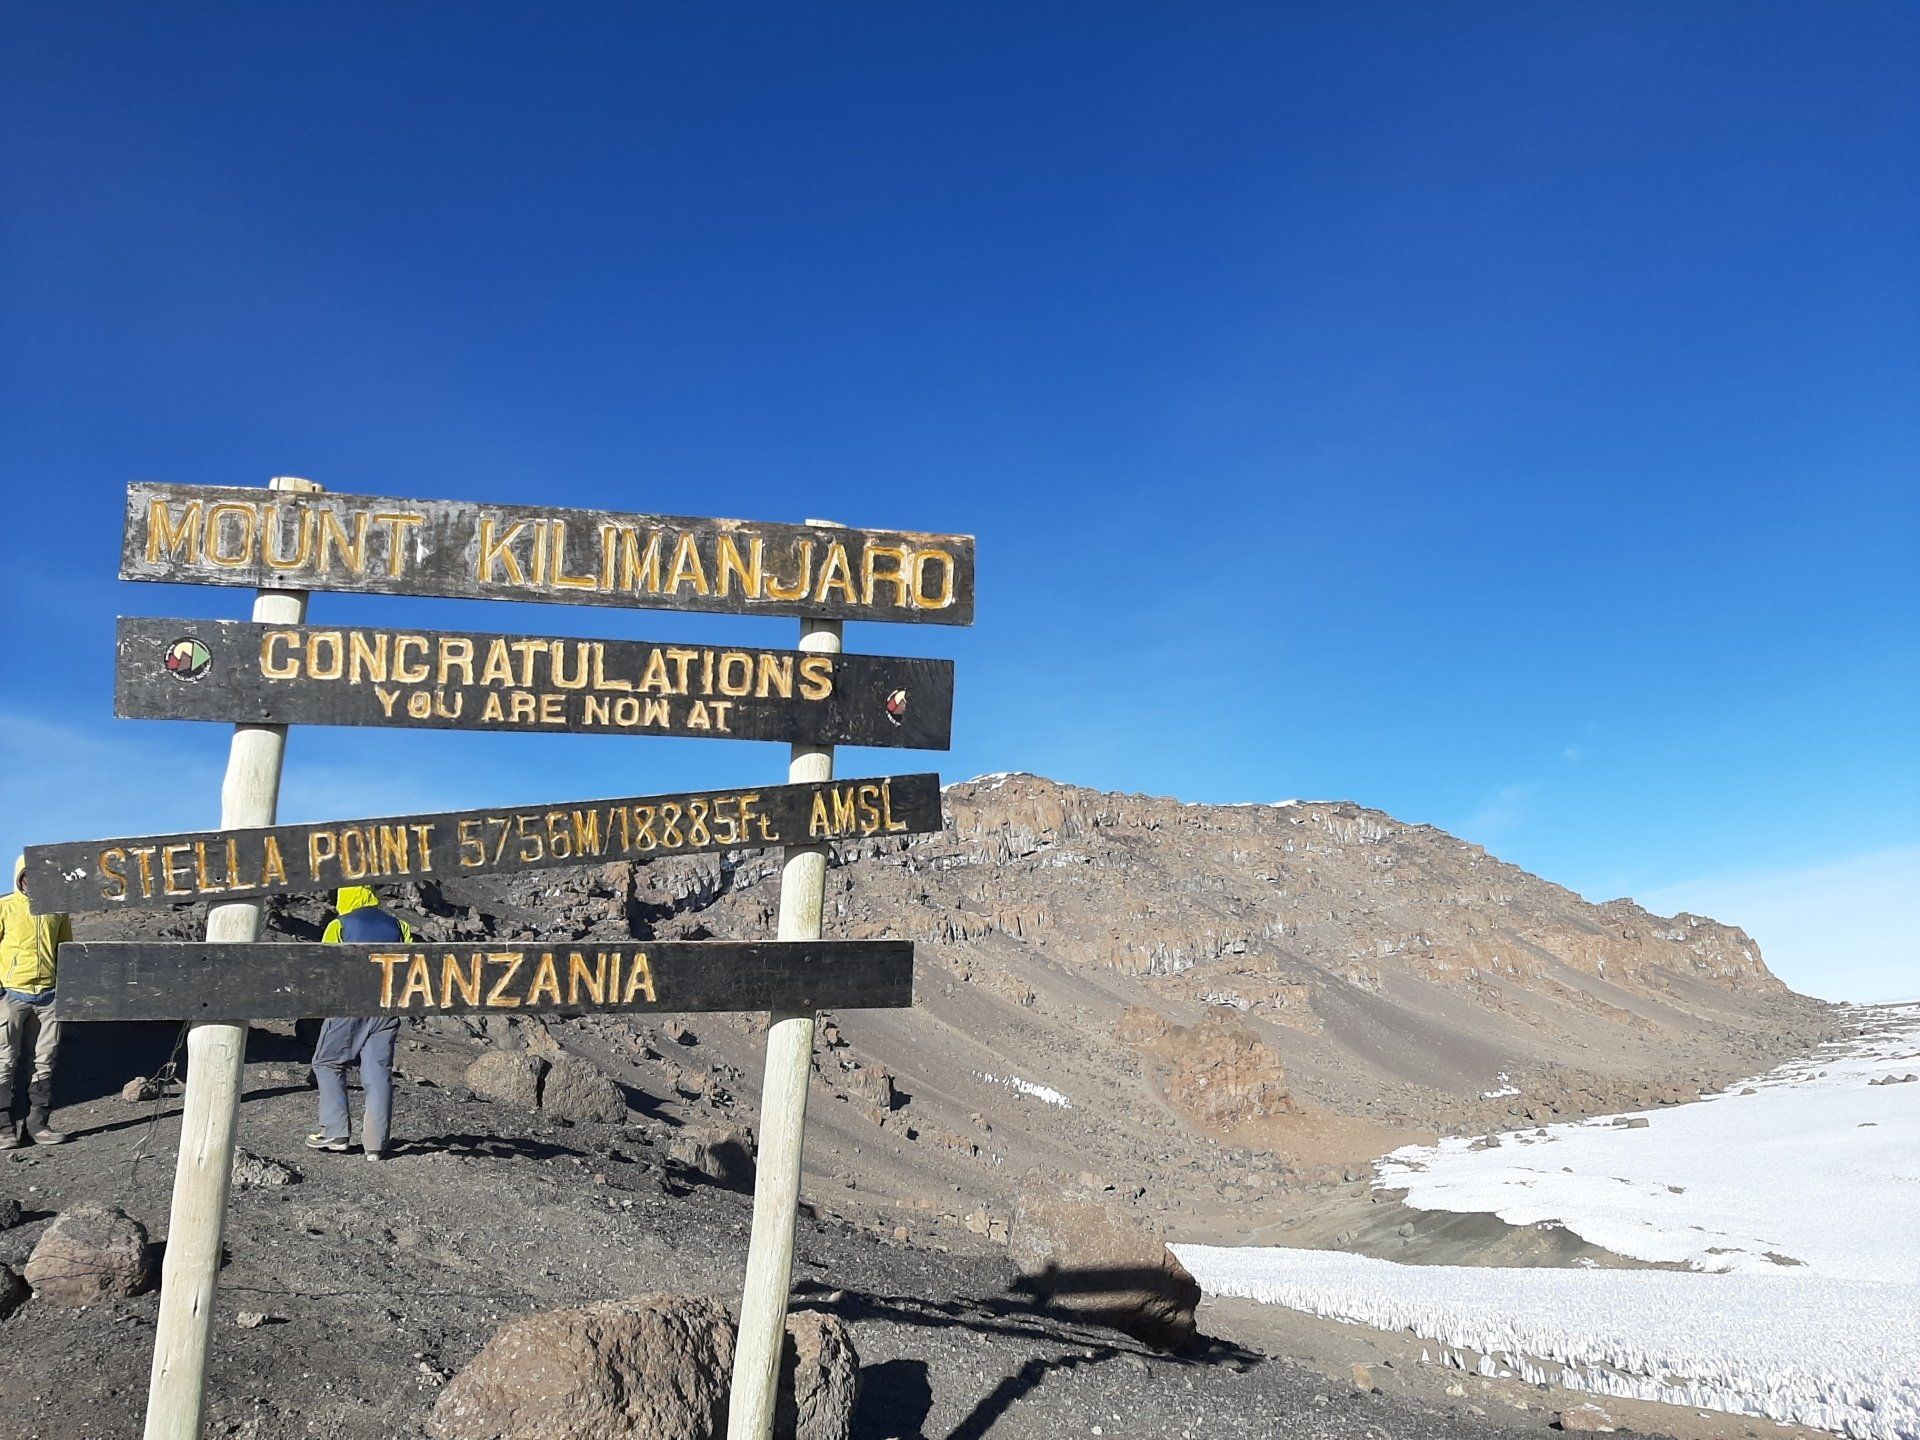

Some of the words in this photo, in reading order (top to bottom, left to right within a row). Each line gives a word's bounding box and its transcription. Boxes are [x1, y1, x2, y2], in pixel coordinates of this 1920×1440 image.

[145, 499, 423, 581] MOUNT
[477, 516, 954, 609] KILIMANJARO
[259, 630, 834, 701] CONGRATULATIONS
[374, 687, 463, 718] YOU
[481, 691, 567, 724] ARE
[581, 693, 671, 728] NOW
[686, 700, 734, 733] AT
[98, 835, 289, 902] STELLA
[308, 822, 436, 882] POINT
[808, 777, 909, 838] AMSL
[368, 952, 657, 1009] TANZANIA
